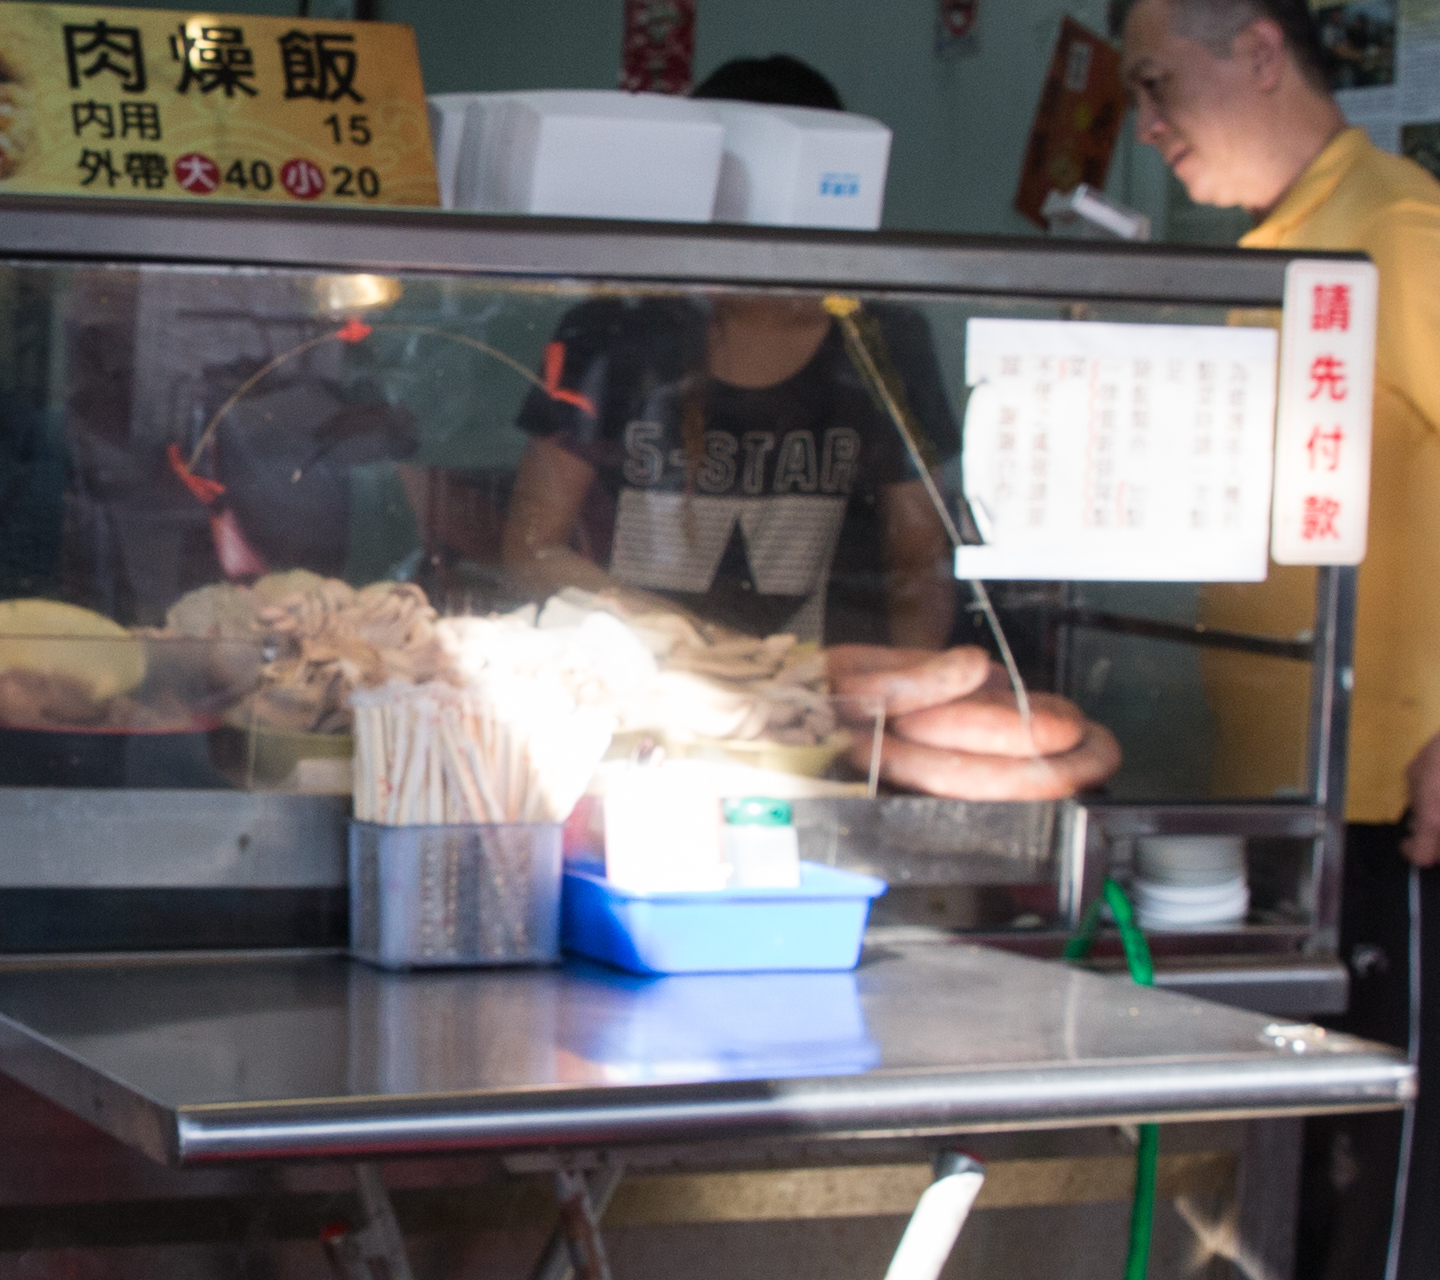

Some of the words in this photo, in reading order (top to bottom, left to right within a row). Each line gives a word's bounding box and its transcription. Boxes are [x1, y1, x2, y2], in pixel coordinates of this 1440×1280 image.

[63, 20, 366, 105] 肉燥飯
[323, 114, 371, 146] 15
[1299, 282, 1353, 543] 請先付款
